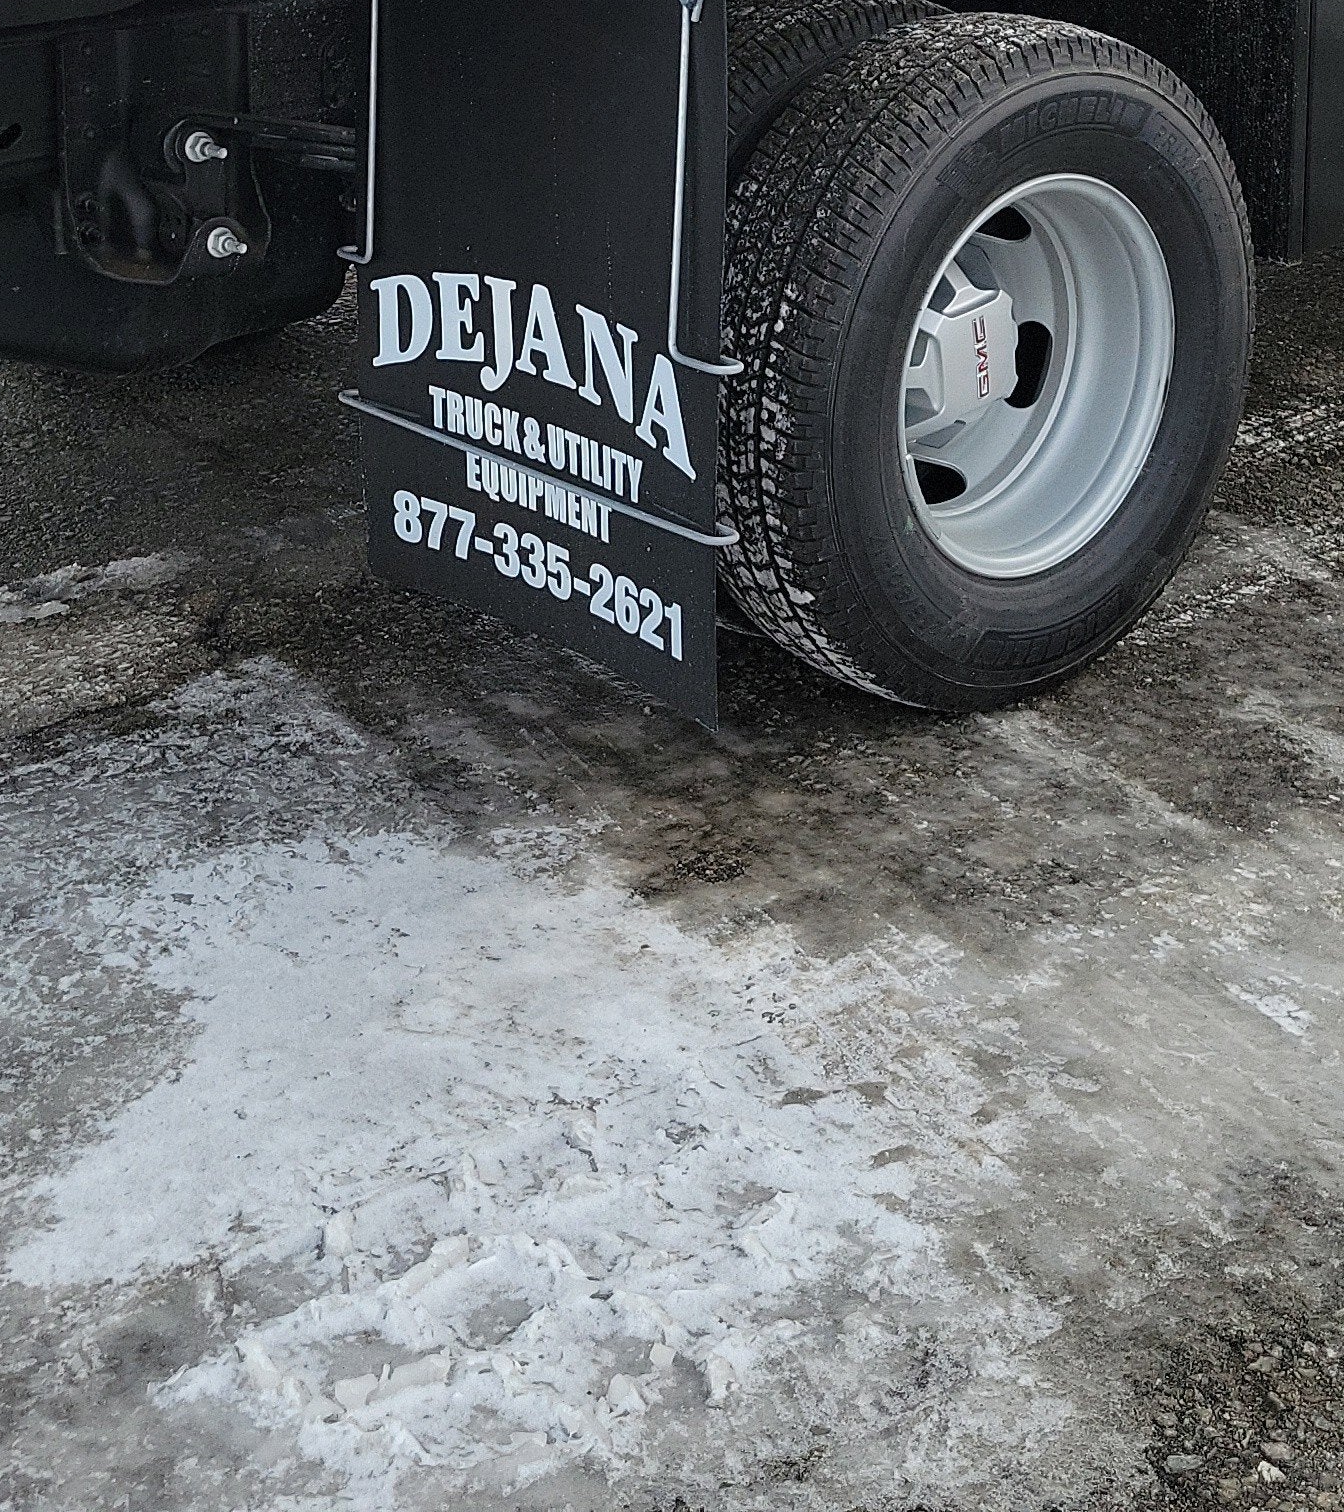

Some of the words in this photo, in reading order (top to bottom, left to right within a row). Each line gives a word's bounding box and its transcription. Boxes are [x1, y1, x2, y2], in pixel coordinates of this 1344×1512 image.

[1000, 95, 1149, 152] MICHELIN
[369, 271, 697, 481] DEJANA
[971, 315, 990, 399] GMC
[465, 451, 613, 543] EQUIPMENT
[393, 490, 683, 661] 877-335-2621
